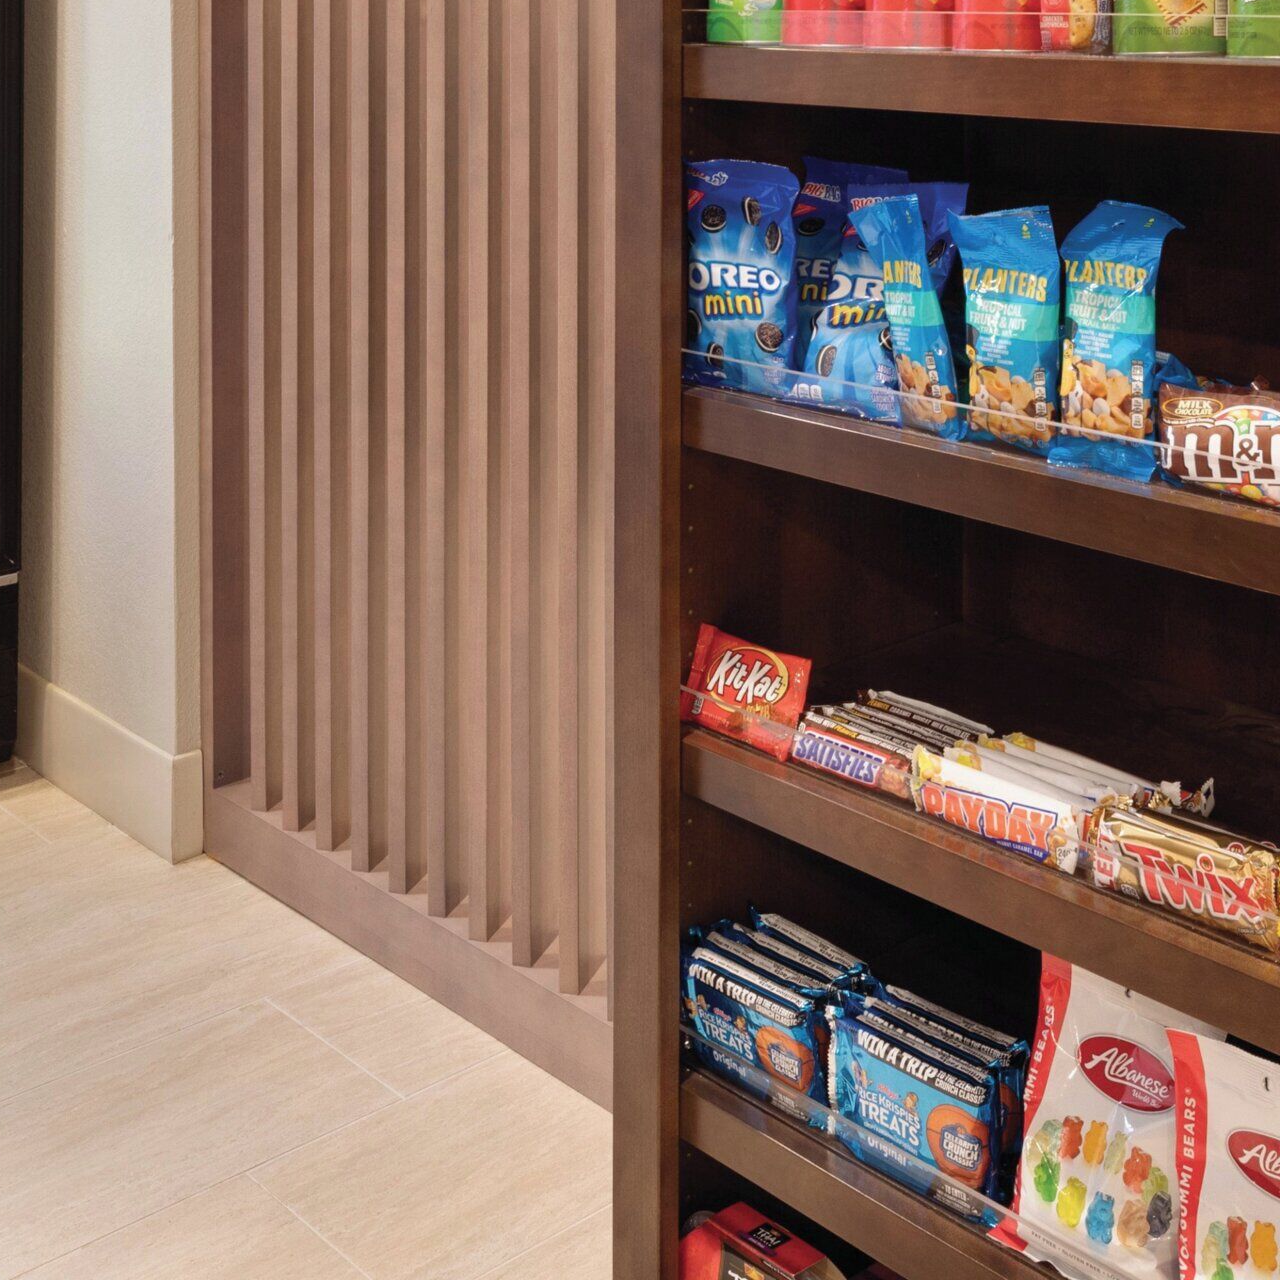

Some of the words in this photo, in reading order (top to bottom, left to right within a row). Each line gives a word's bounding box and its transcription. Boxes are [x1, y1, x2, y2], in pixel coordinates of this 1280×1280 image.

[689, 261, 780, 291] OREO
[963, 267, 1048, 303] PLANTERS
[705, 290, 763, 317] mini
[1178, 400, 1212, 411] MILK
[922, 783, 1058, 851] PAYDAY
[725, 981, 758, 1007] TRIP
[703, 1019, 755, 1061] TREATS
[1033, 1004, 1055, 1062] BEARS
[857, 1028, 886, 1058] WIN
[886, 1045, 899, 1066] A
[899, 1051, 938, 1081] TRIP
[1084, 1047, 1172, 1099] Albanese
[858, 1099, 921, 1147] TREATS
[878, 1093, 921, 1129] KRISPIES
[1182, 1096, 1197, 1160] BEARS
[942, 1139, 980, 1162] CRUNCH
[943, 1131, 981, 1152] CELEBRITY
[946, 1150, 975, 1169] CLASSIC
